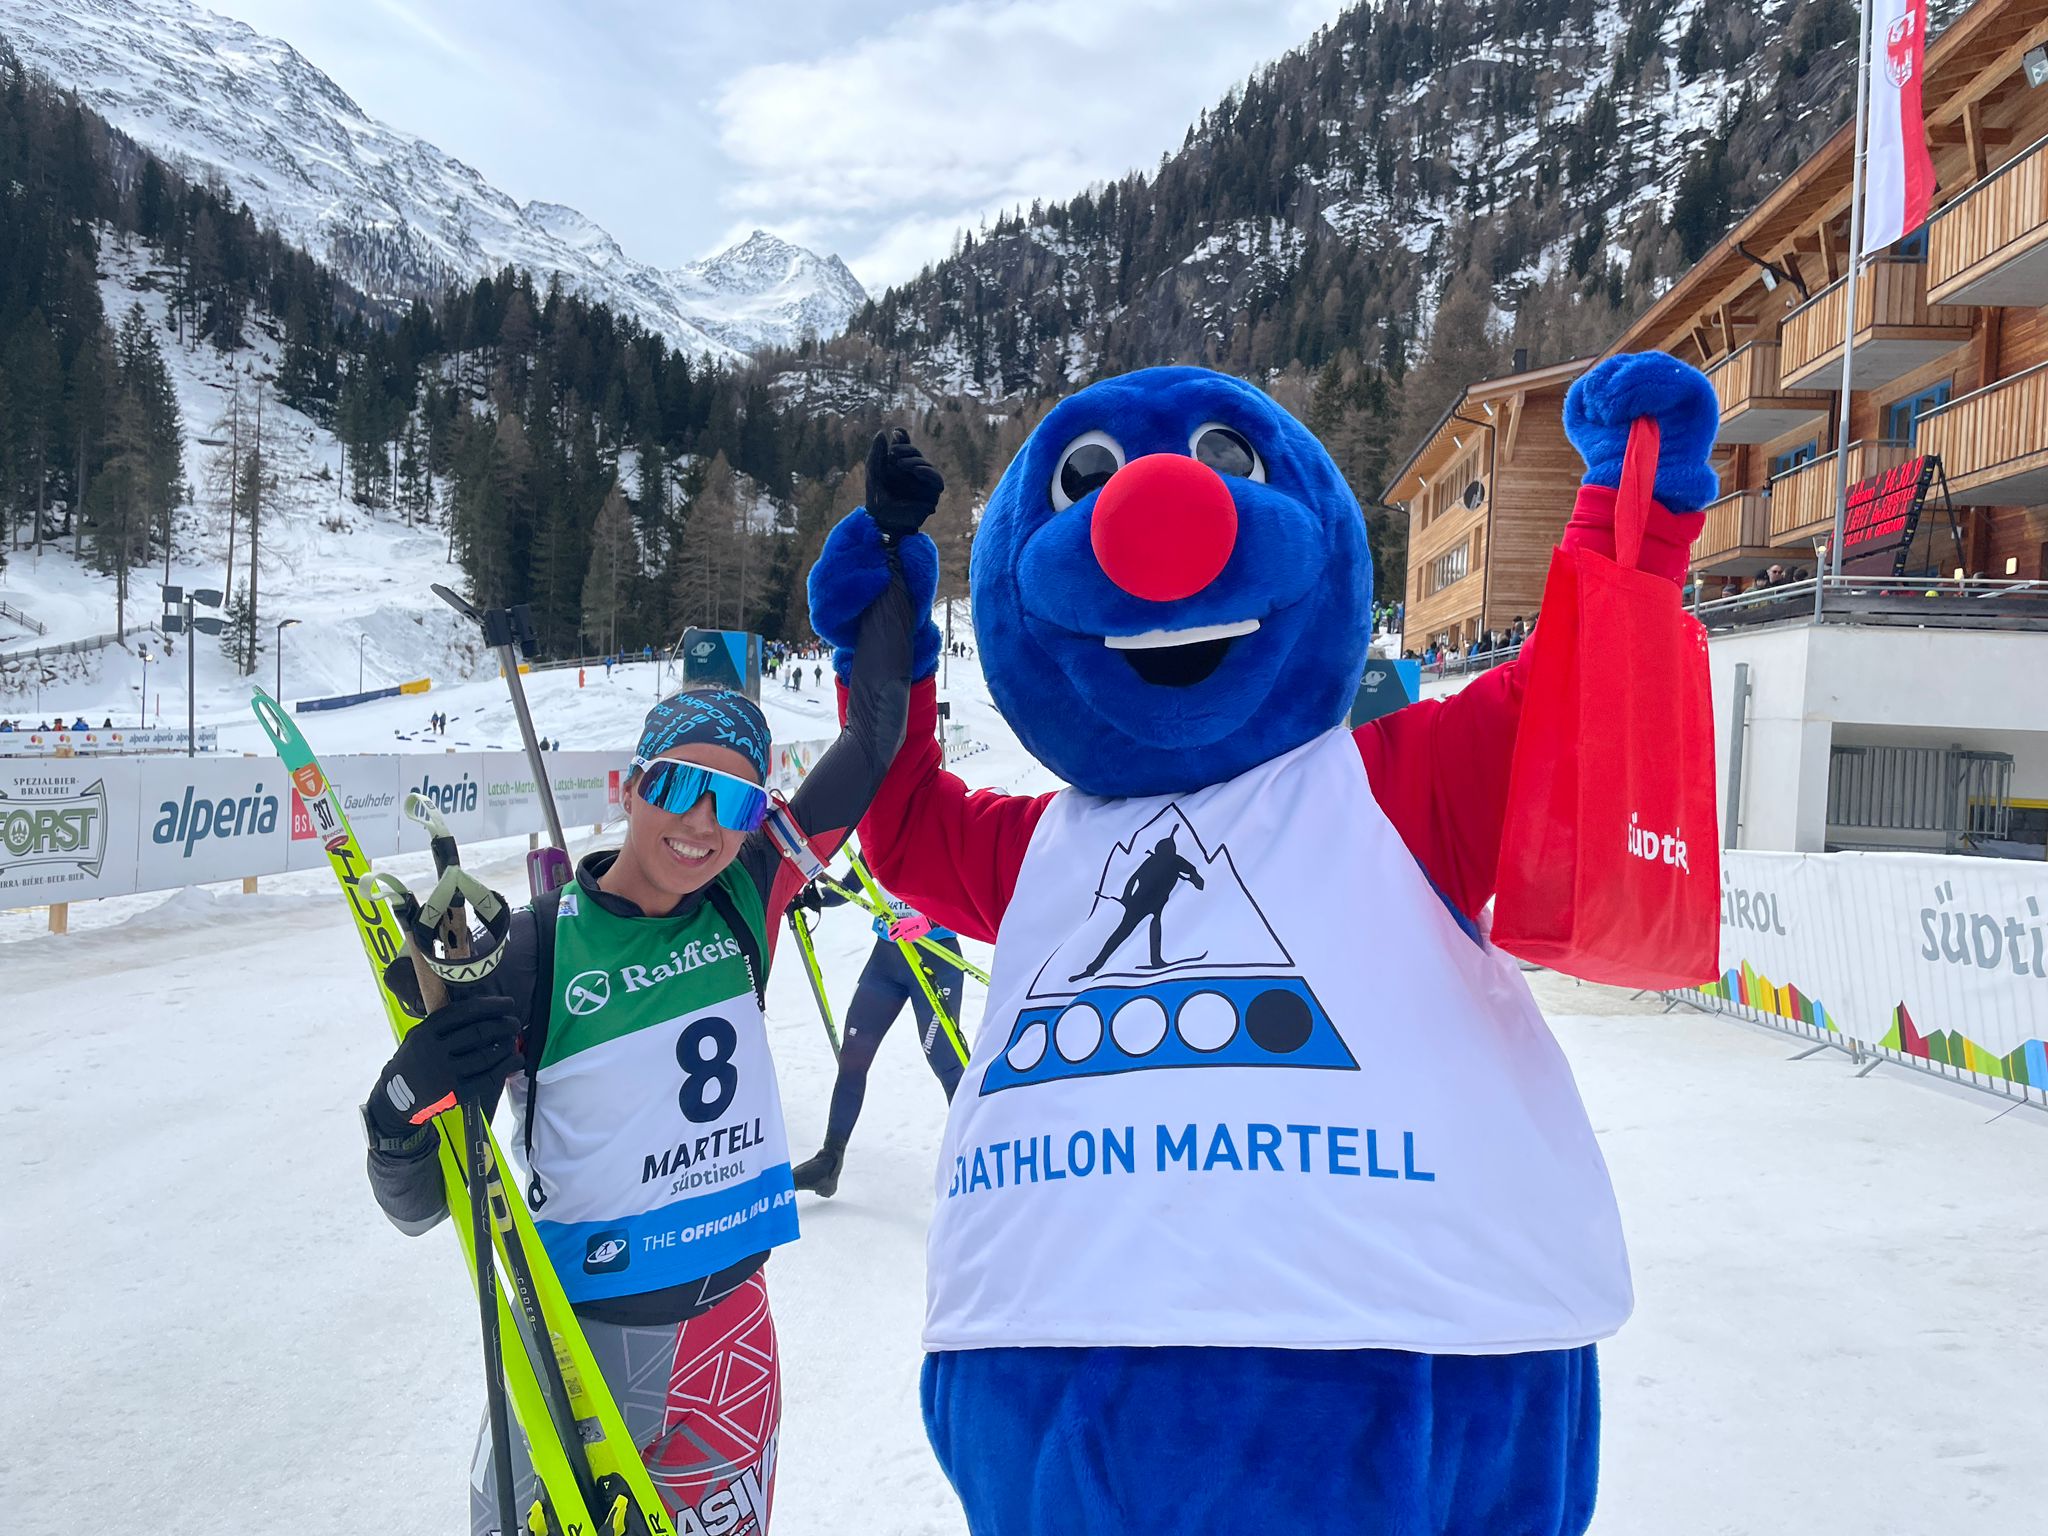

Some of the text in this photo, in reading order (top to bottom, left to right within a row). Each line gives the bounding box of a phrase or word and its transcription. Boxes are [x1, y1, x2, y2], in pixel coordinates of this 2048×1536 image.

[129, 731, 150, 745] alperia
[153, 731, 174, 744] alperia
[21, 787, 69, 796] BRAUEREI
[344, 793, 395, 809] Gaulhofer
[487, 780, 539, 796] Latsch-Martel
[152, 783, 279, 858] alperia
[312, 798, 335, 831] 317
[0, 879, 19, 889] IRRA
[620, 933, 741, 993] Raiffeis
[676, 1016, 738, 1124] 8
[641, 1117, 764, 1184] MARTELL
[1156, 1123, 1436, 1182] MARTELL
[642, 1230, 676, 1252] THE
[680, 1209, 748, 1243] OFFICIAL
[749, 1197, 769, 1220] IBU
